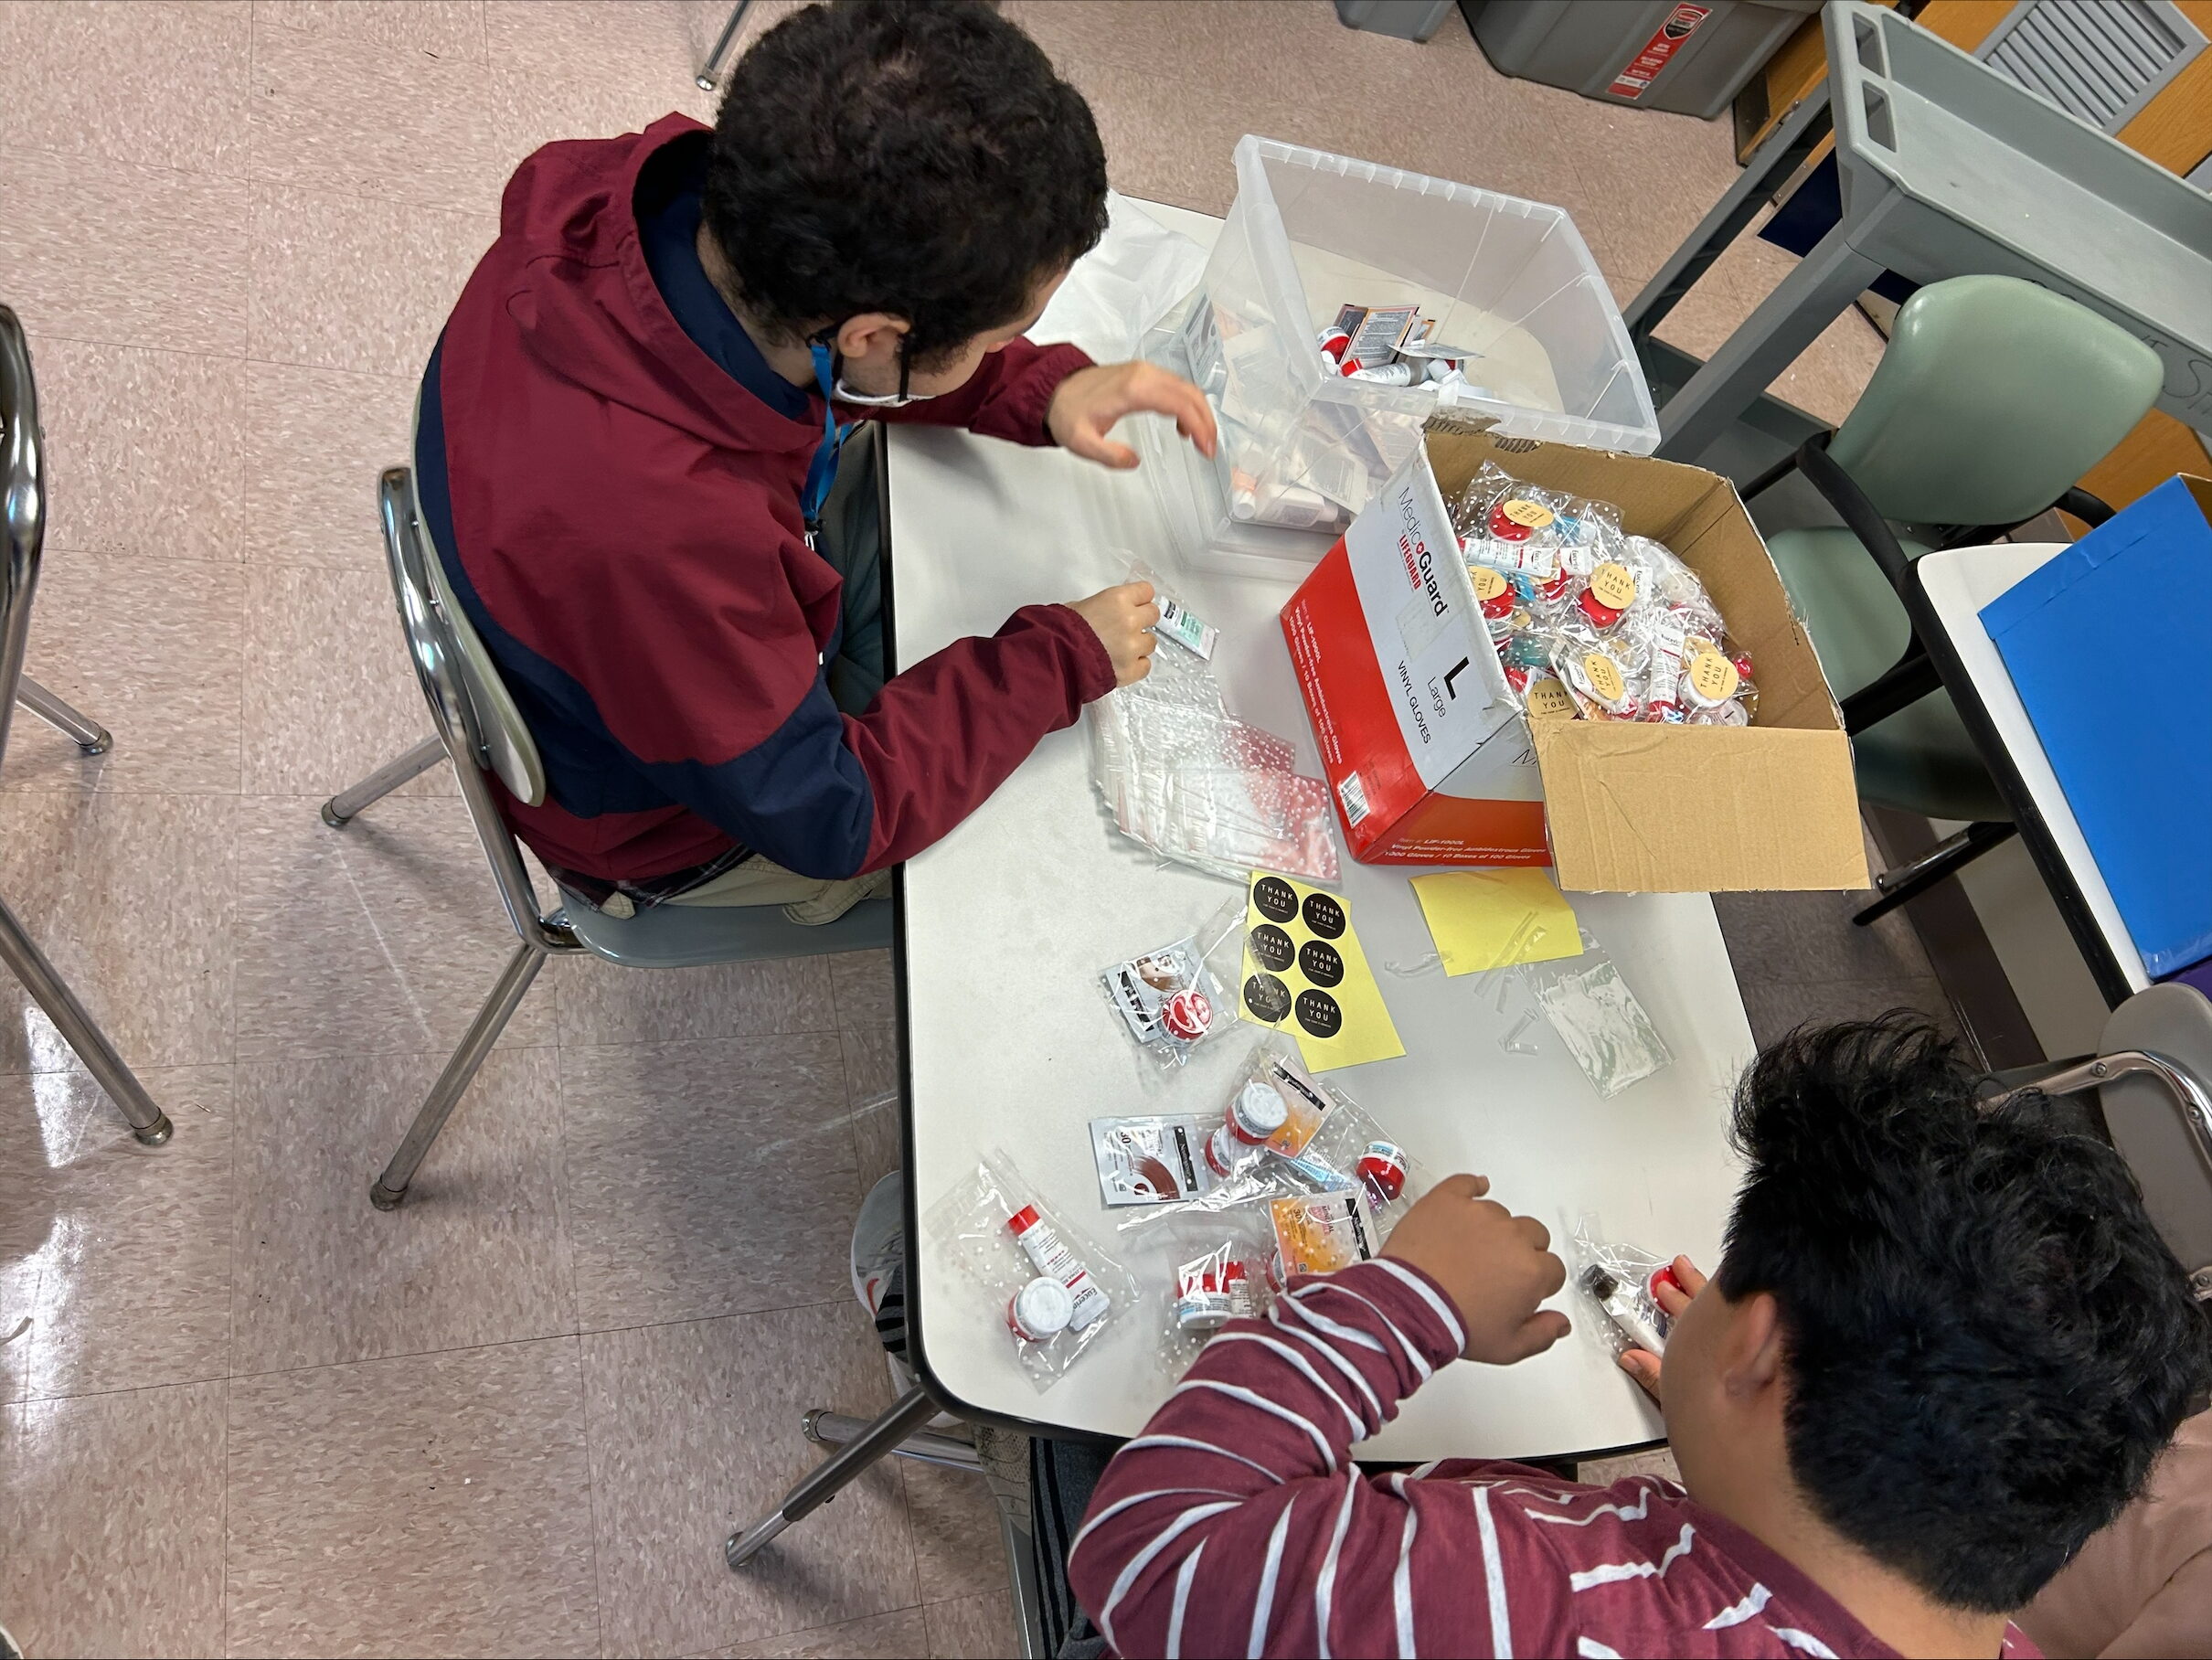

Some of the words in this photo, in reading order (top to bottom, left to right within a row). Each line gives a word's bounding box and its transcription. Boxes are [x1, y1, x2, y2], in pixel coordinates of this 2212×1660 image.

[1510, 504, 1532, 516] THANK
[1524, 511, 1537, 519] YOU
[1399, 534, 1421, 590] LIFEGUARD
[1477, 578, 1487, 591] YOU
[1601, 569, 1631, 590] THANK
[1604, 580, 1622, 594] YOU
[1443, 656, 1470, 700] L
[1592, 661, 1606, 691] THANK
[1601, 668, 1610, 687] YOU
[1700, 657, 1713, 688] THANK
[1711, 666, 1721, 686] YOU
[1294, 636, 1304, 665] Gloves
[1307, 682, 1317, 708] Boxes
[1324, 735, 1334, 764] Gloves
[1300, 628, 1316, 677] Powder-free
[1314, 677, 1334, 735] Ambidextrous
[1332, 735, 1343, 764] Gloves
[1398, 660, 1412, 697] VINYL
[1409, 697, 1431, 744] GLOVES
[1427, 676, 1446, 718] Large
[1543, 700, 1565, 708] YOU
[1261, 884, 1293, 901] THANK
[1267, 896, 1286, 908] YOU
[1309, 900, 1340, 918] THANK
[1315, 912, 1334, 924] YOU
[1257, 932, 1290, 949] THANK
[1262, 944, 1282, 955] YOU
[1305, 948, 1338, 964] THANK
[1312, 960, 1331, 972] YOU
[1252, 982, 1286, 997] THNK
[1303, 997, 1335, 1014] THANK
[1309, 1010, 1328, 1021] YOU
